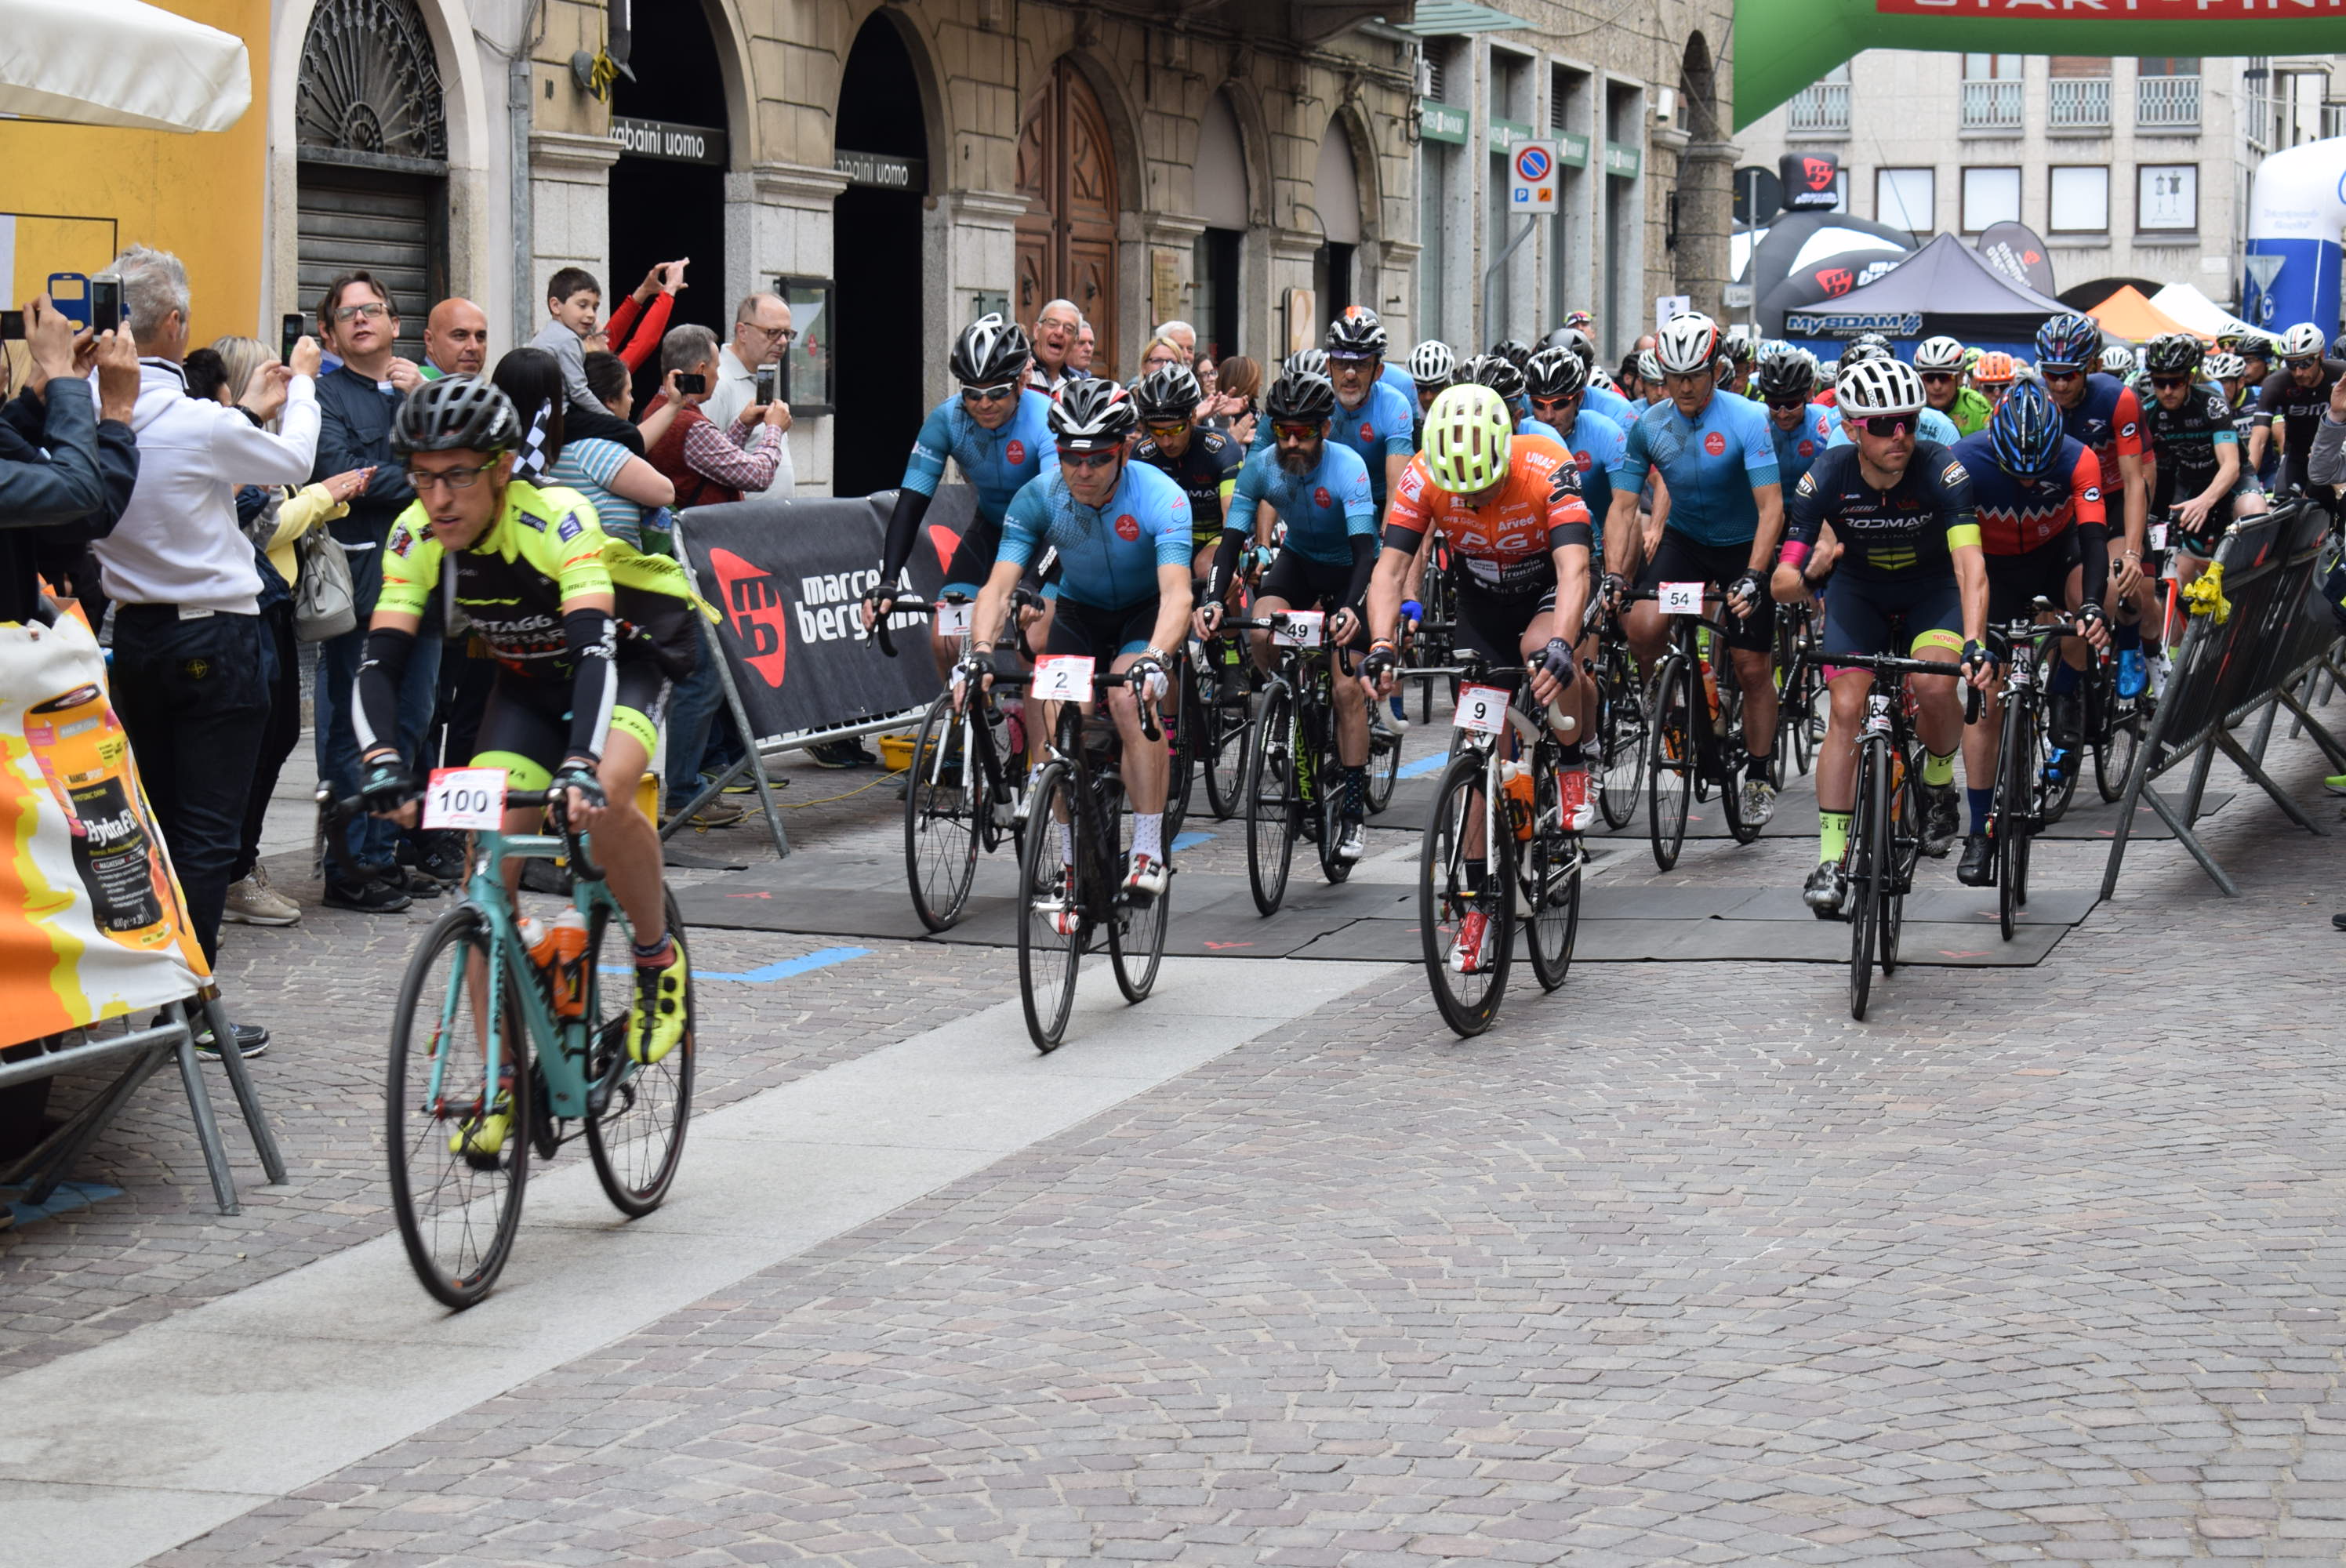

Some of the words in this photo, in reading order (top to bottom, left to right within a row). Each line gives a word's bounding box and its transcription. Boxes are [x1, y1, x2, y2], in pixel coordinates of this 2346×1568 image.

[666, 132, 705, 158] uomo
[877, 162, 909, 186] uomo
[1787, 315, 1901, 336] MySDAM
[1498, 513, 1537, 532] Arvedi
[1670, 592, 1690, 605] 54
[955, 611, 963, 626] 1
[1287, 623, 1308, 638] 49
[1055, 672, 1067, 689] 2
[1474, 702, 1487, 720] 9
[440, 789, 488, 813] 100
